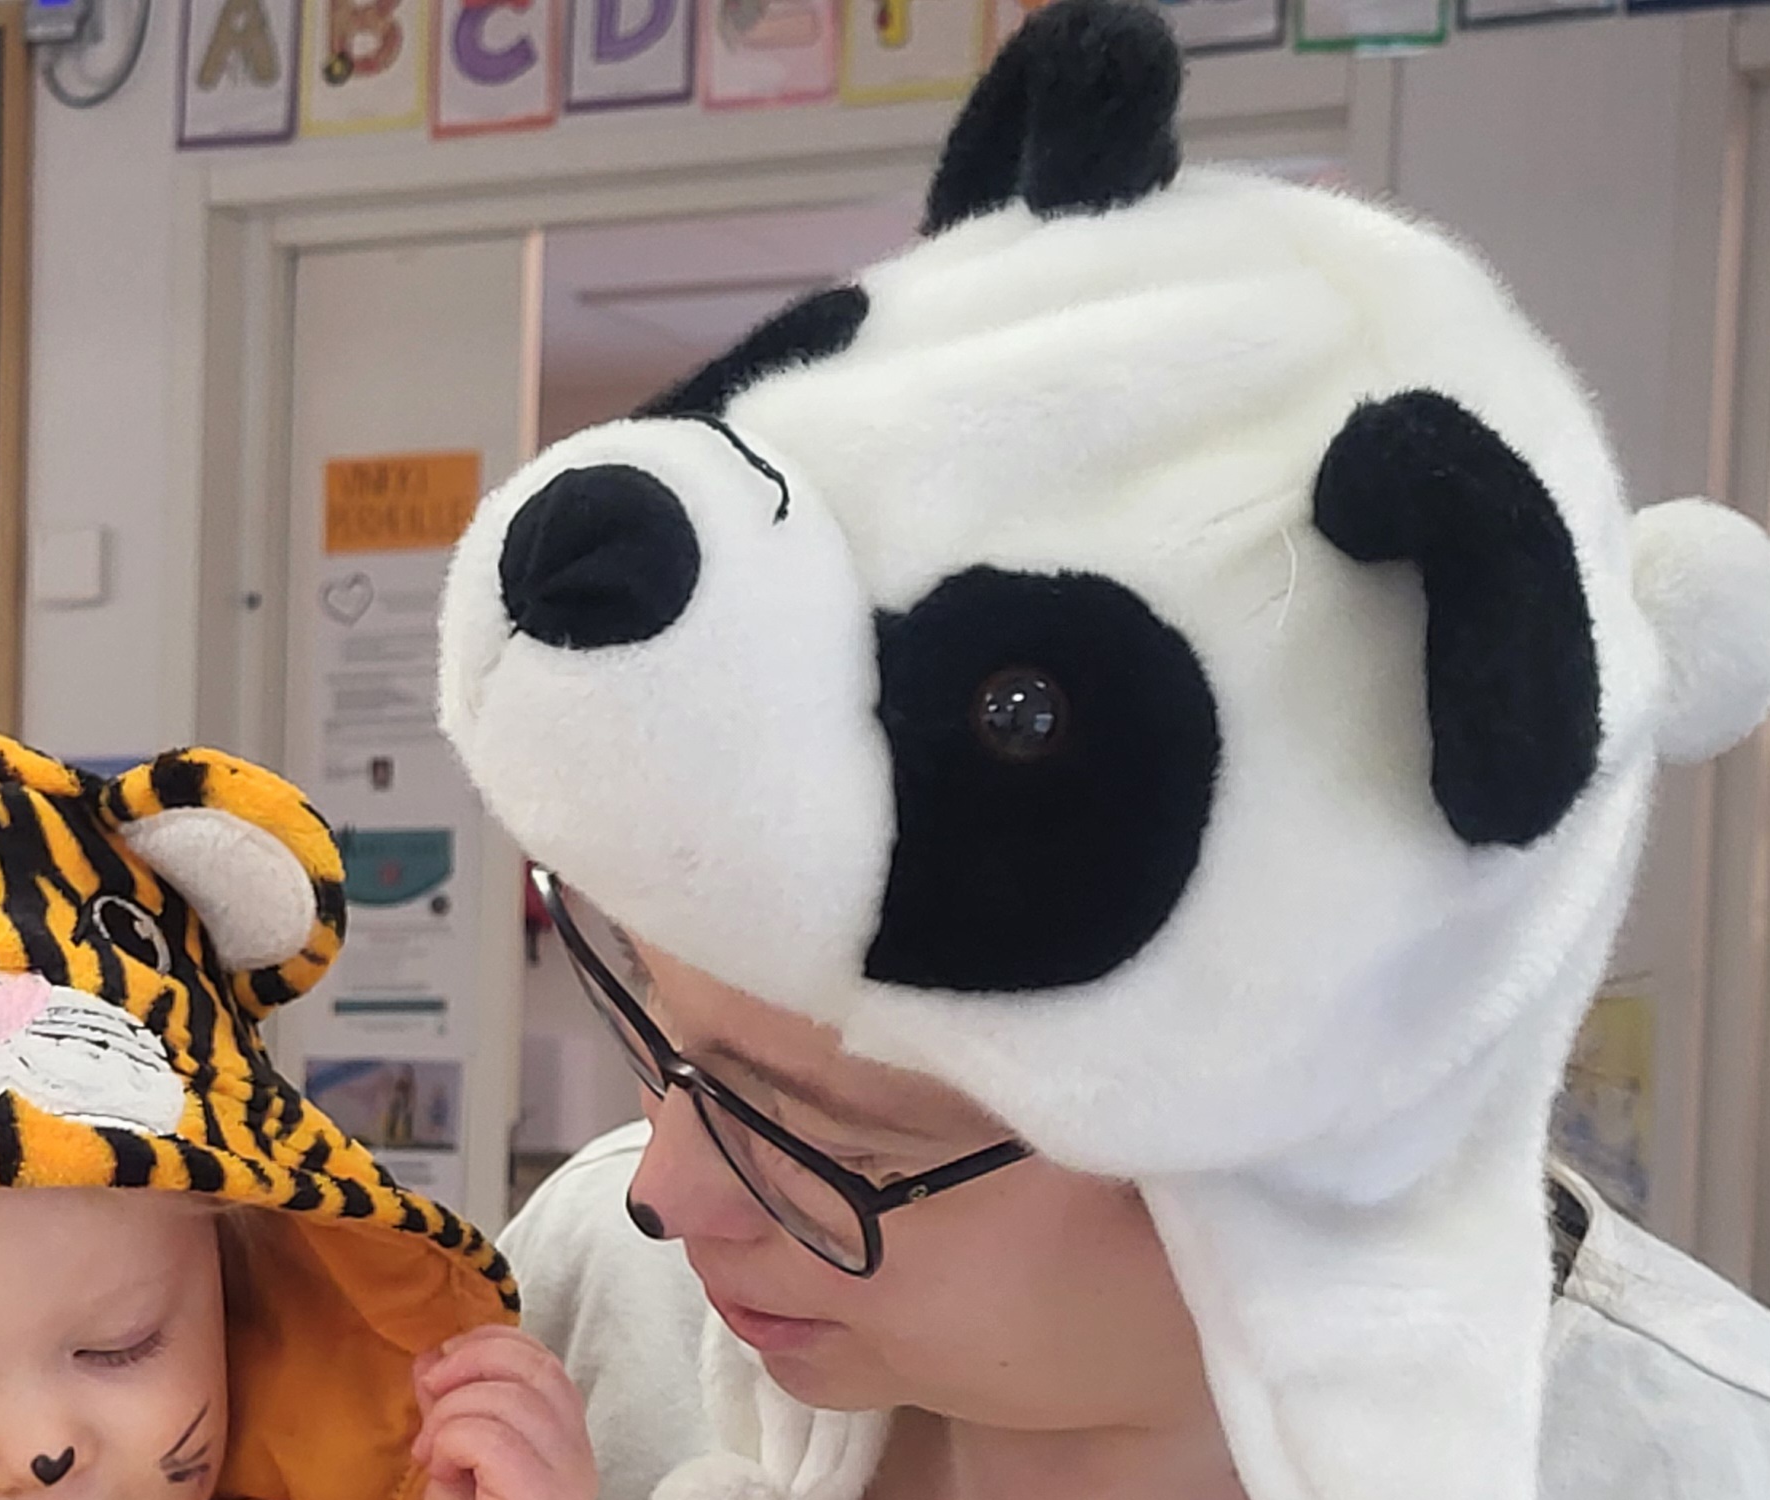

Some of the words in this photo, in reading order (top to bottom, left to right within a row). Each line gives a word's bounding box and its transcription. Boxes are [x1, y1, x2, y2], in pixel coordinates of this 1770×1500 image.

[196, 0, 280, 90] A
[326, 0, 403, 80] B
[452, 0, 537, 86] C
